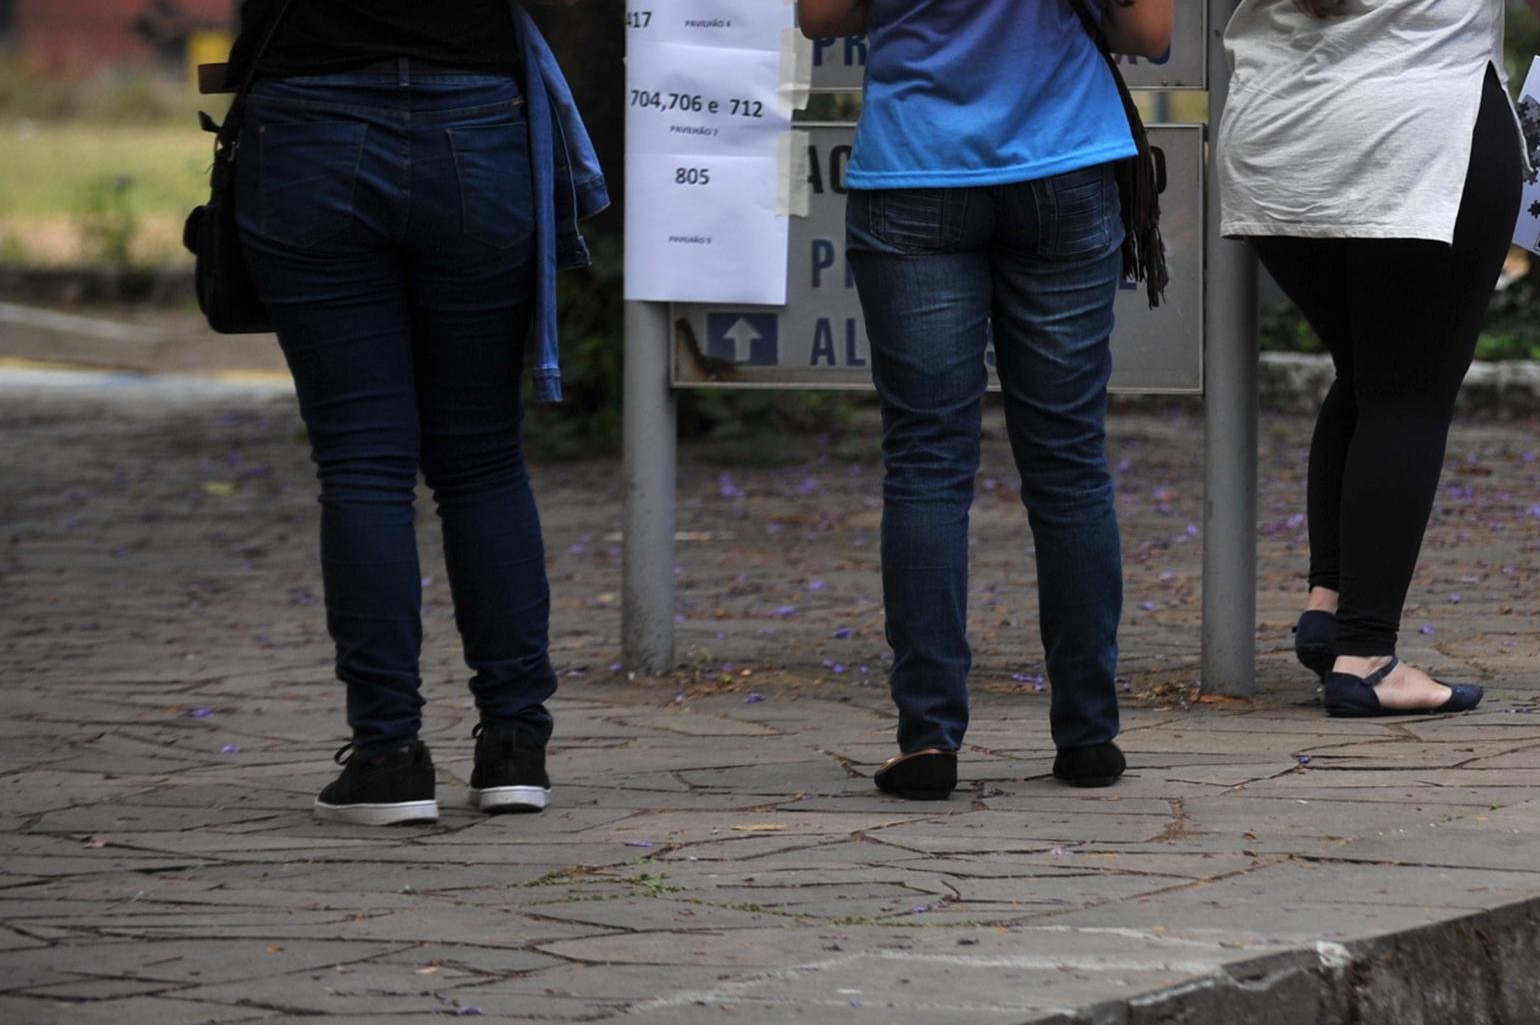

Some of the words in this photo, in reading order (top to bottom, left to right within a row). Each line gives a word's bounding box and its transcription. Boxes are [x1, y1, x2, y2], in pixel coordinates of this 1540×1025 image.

[630, 90, 702, 112] 704,706
[707, 100, 719, 113] e
[729, 99, 763, 117] 712
[675, 167, 710, 185] 805
